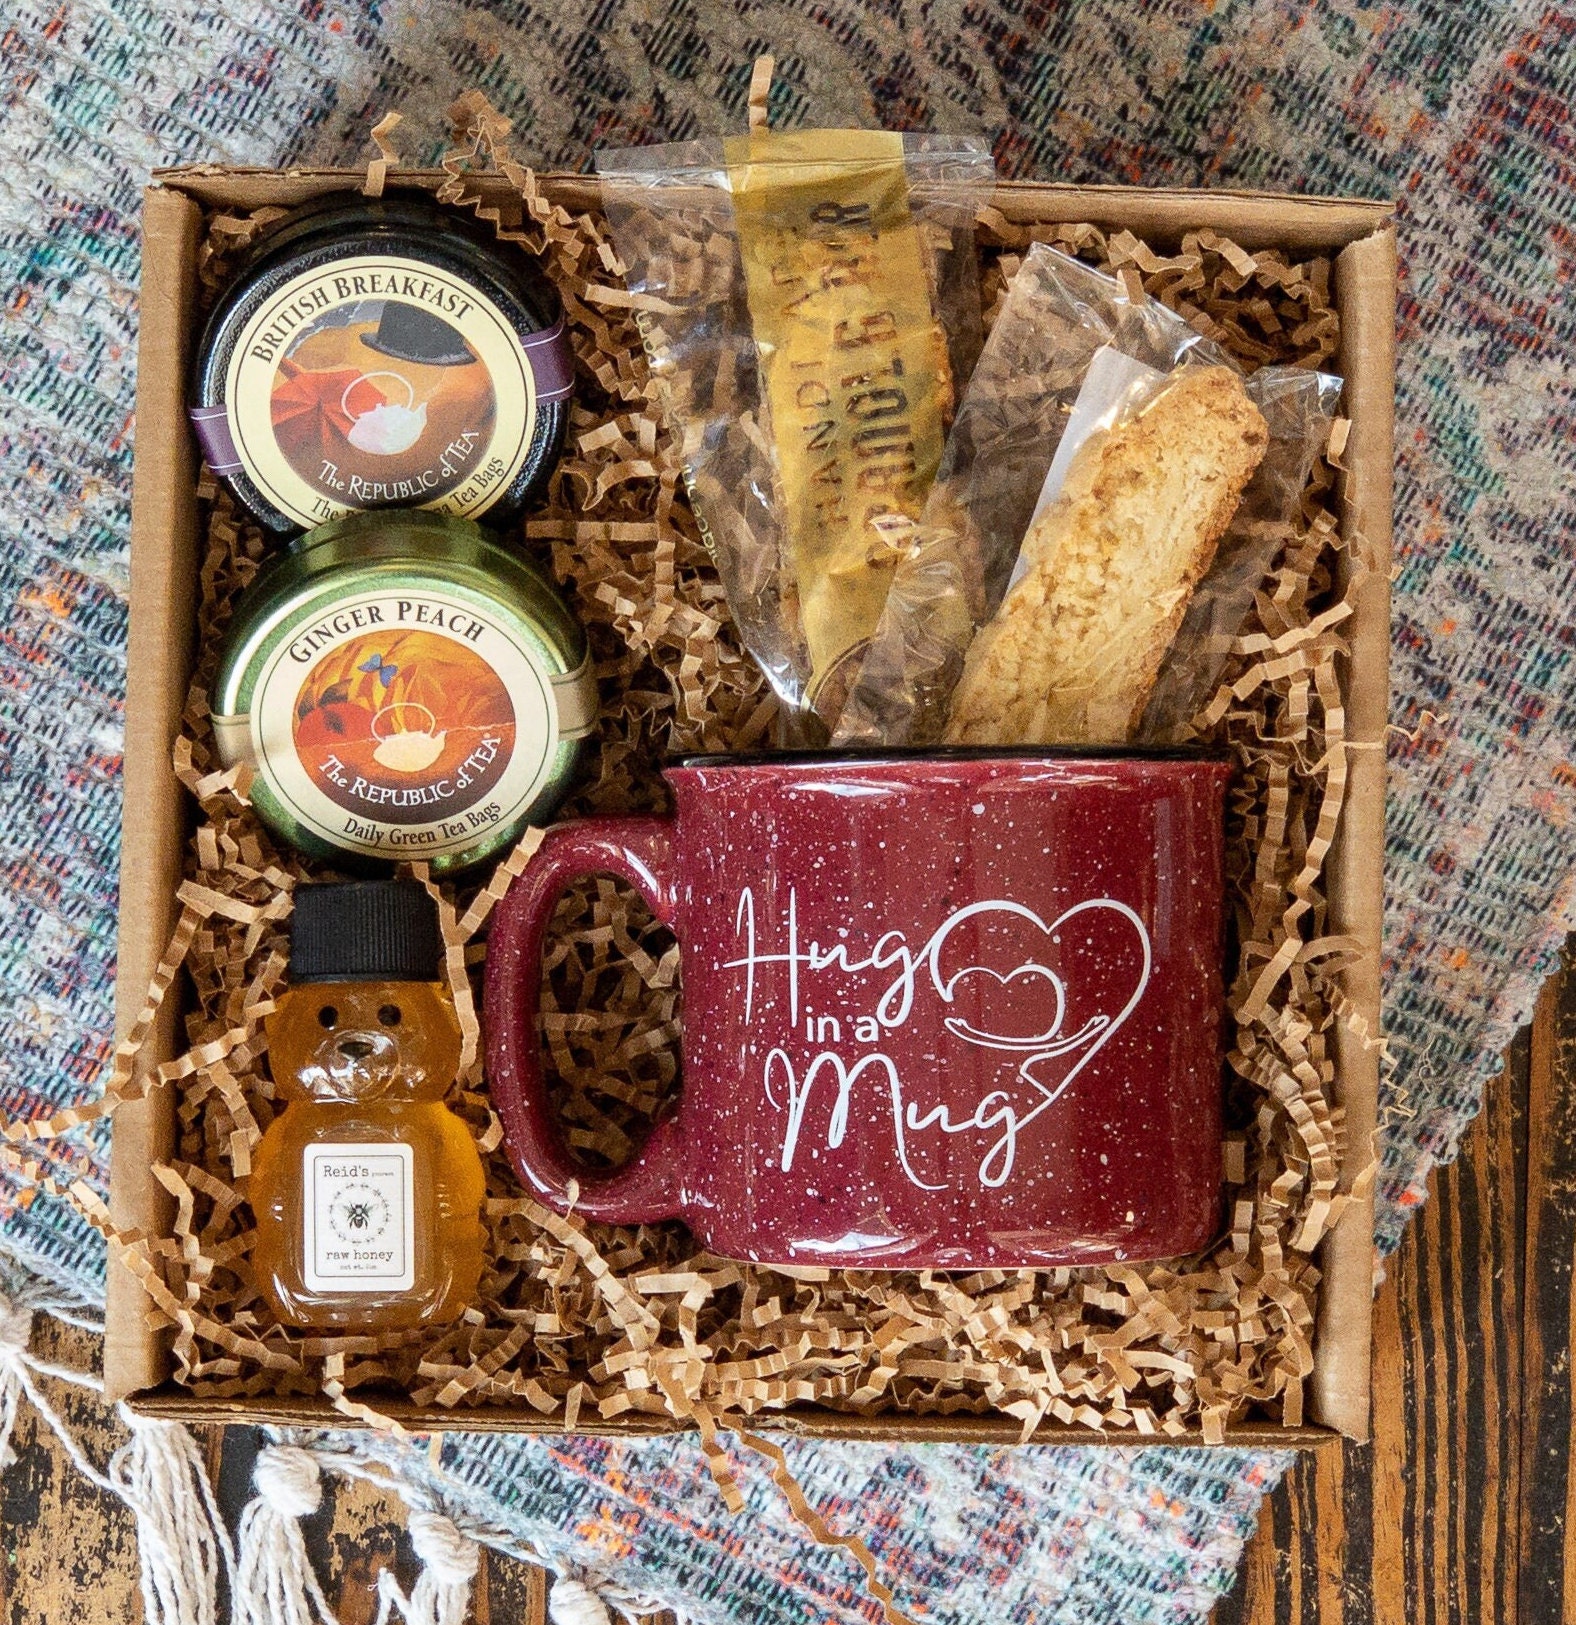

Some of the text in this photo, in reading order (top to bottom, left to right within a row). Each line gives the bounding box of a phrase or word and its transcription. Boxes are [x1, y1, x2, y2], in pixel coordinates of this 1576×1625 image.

[250, 274, 474, 364] BRITISH BREAKFAST
[311, 456, 505, 521] The Tea Bags
[317, 431, 479, 501] The REPUBLIC of TEA
[289, 600, 486, 665] GINGER PEACH
[318, 735, 502, 807] The REPUBLIC of TEA
[342, 800, 501, 848] Daily Green Tea Bags
[723, 886, 924, 1028] Hug
[806, 1006, 879, 1042] in a
[764, 1047, 1017, 1190] Mug
[323, 1165, 369, 1177] Reid's
[326, 1249, 394, 1262] raw honey
